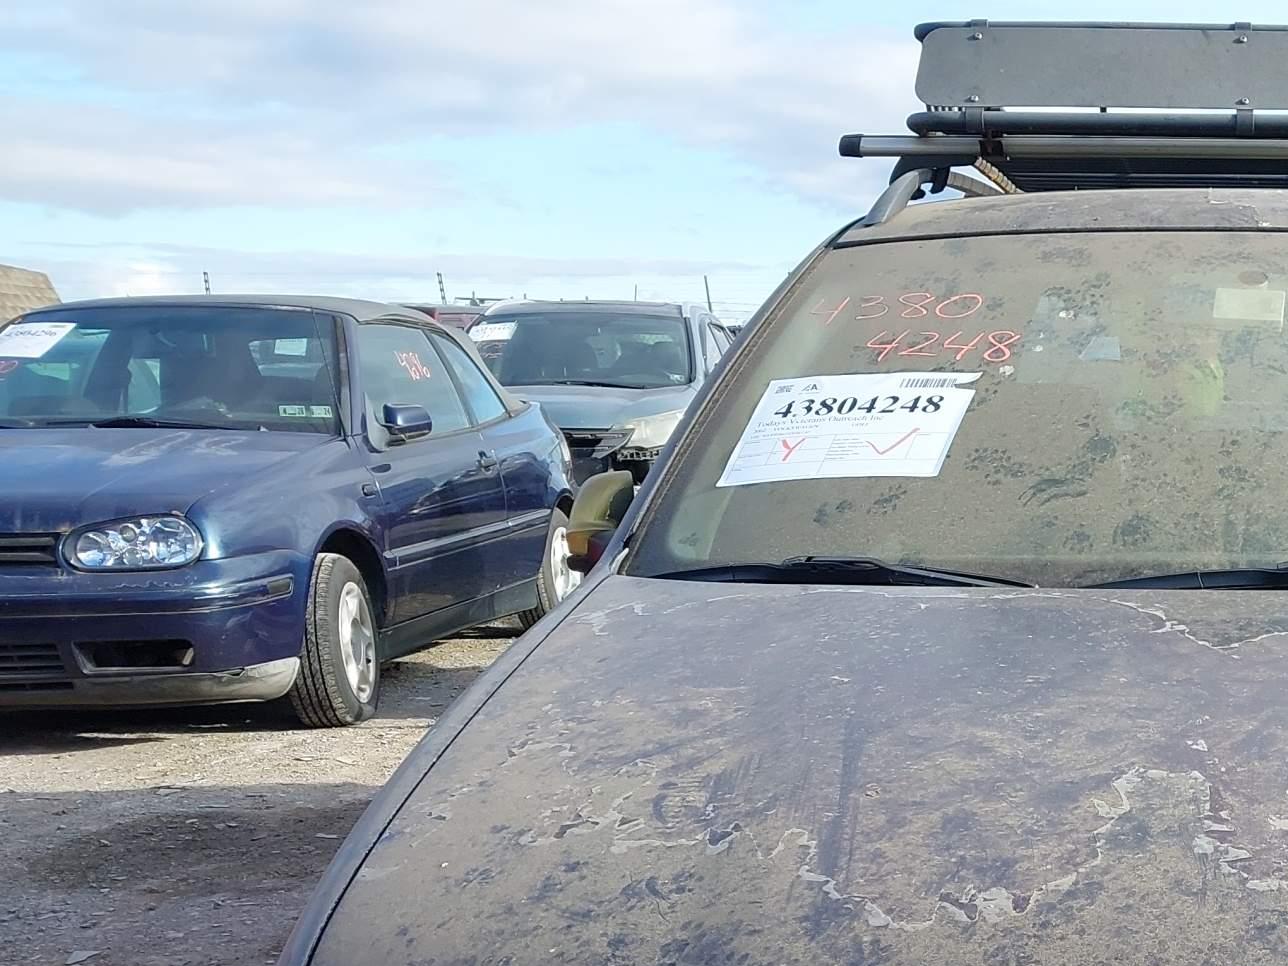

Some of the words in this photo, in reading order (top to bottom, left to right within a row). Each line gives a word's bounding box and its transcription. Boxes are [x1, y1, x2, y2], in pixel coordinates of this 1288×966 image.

[809, 292, 983, 325] 4380
[866, 329, 1021, 362] 4248
[773, 394, 944, 419] 43804248
